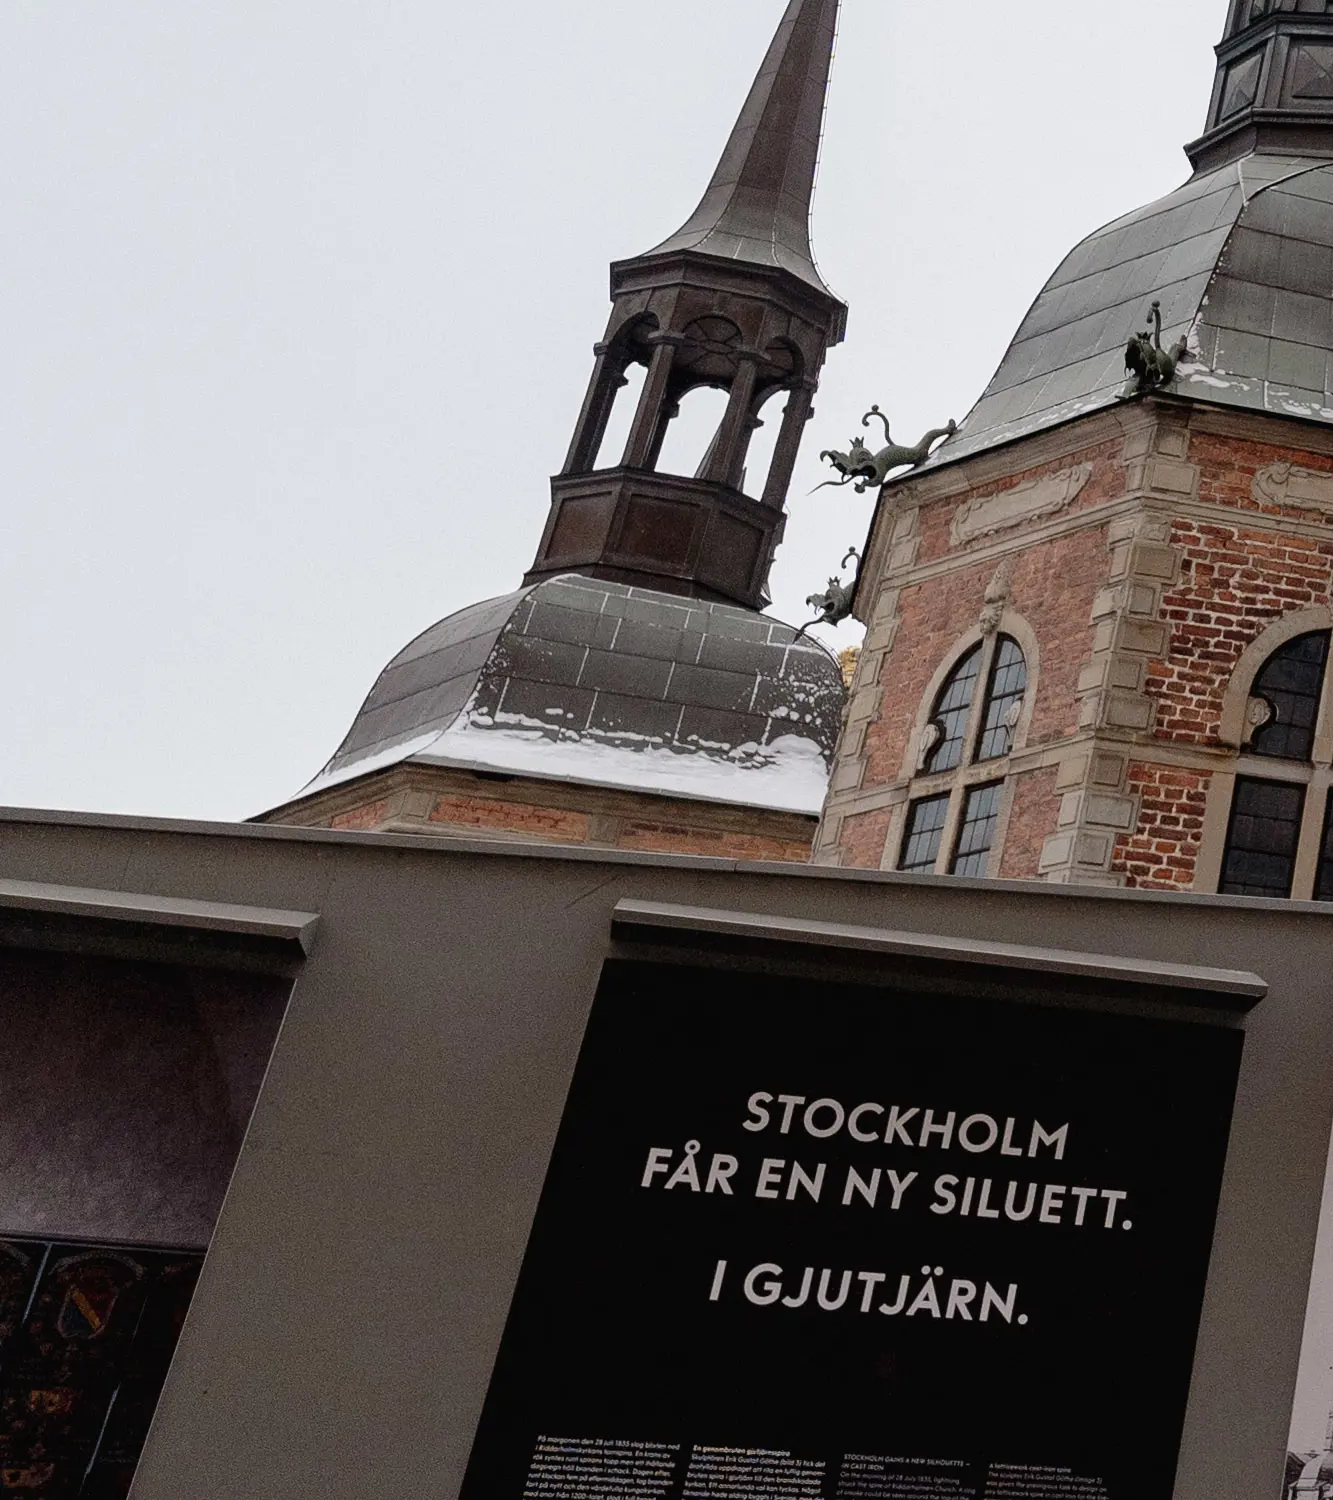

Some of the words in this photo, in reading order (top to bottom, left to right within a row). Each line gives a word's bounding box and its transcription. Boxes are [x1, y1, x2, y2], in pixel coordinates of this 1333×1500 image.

[742, 1091, 1069, 1160] STOCKHOLM
[640, 1139, 739, 1195] FÅR
[754, 1157, 827, 1203] EN
[841, 1165, 918, 1210] NY
[929, 1173, 1132, 1230] SILUETT.
[708, 1259, 727, 1301] I
[743, 1262, 1028, 1325] GJUTJÄRN.
